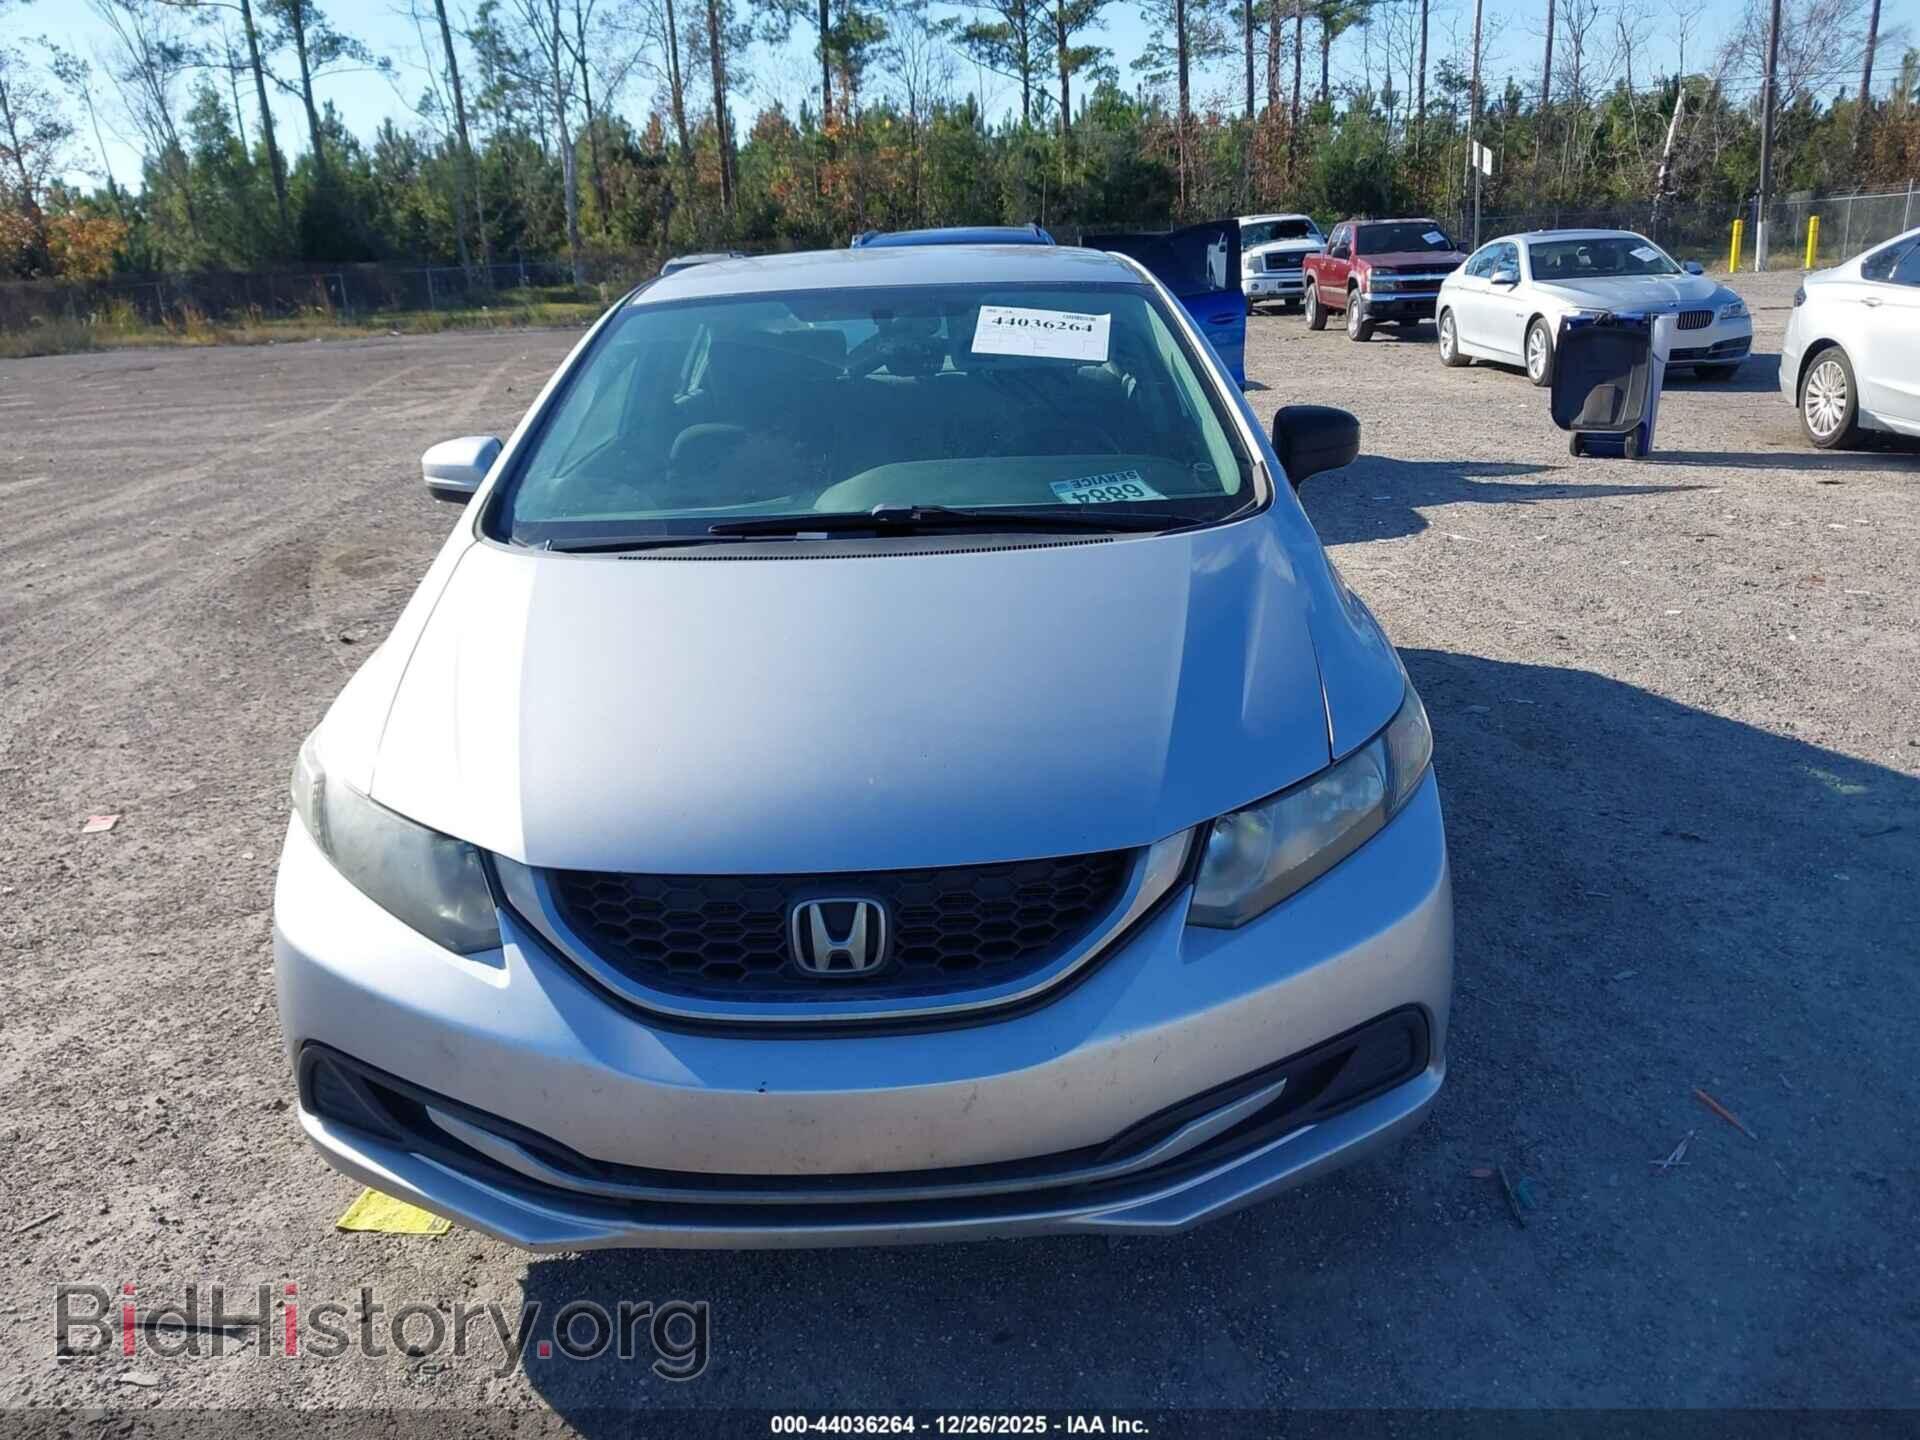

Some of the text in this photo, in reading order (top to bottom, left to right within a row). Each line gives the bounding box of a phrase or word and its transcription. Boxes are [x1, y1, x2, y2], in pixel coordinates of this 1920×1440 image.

[991, 316, 1093, 333] 44036264
[1071, 471, 1137, 489] SERVICE
[1072, 484, 1145, 504] 6884
